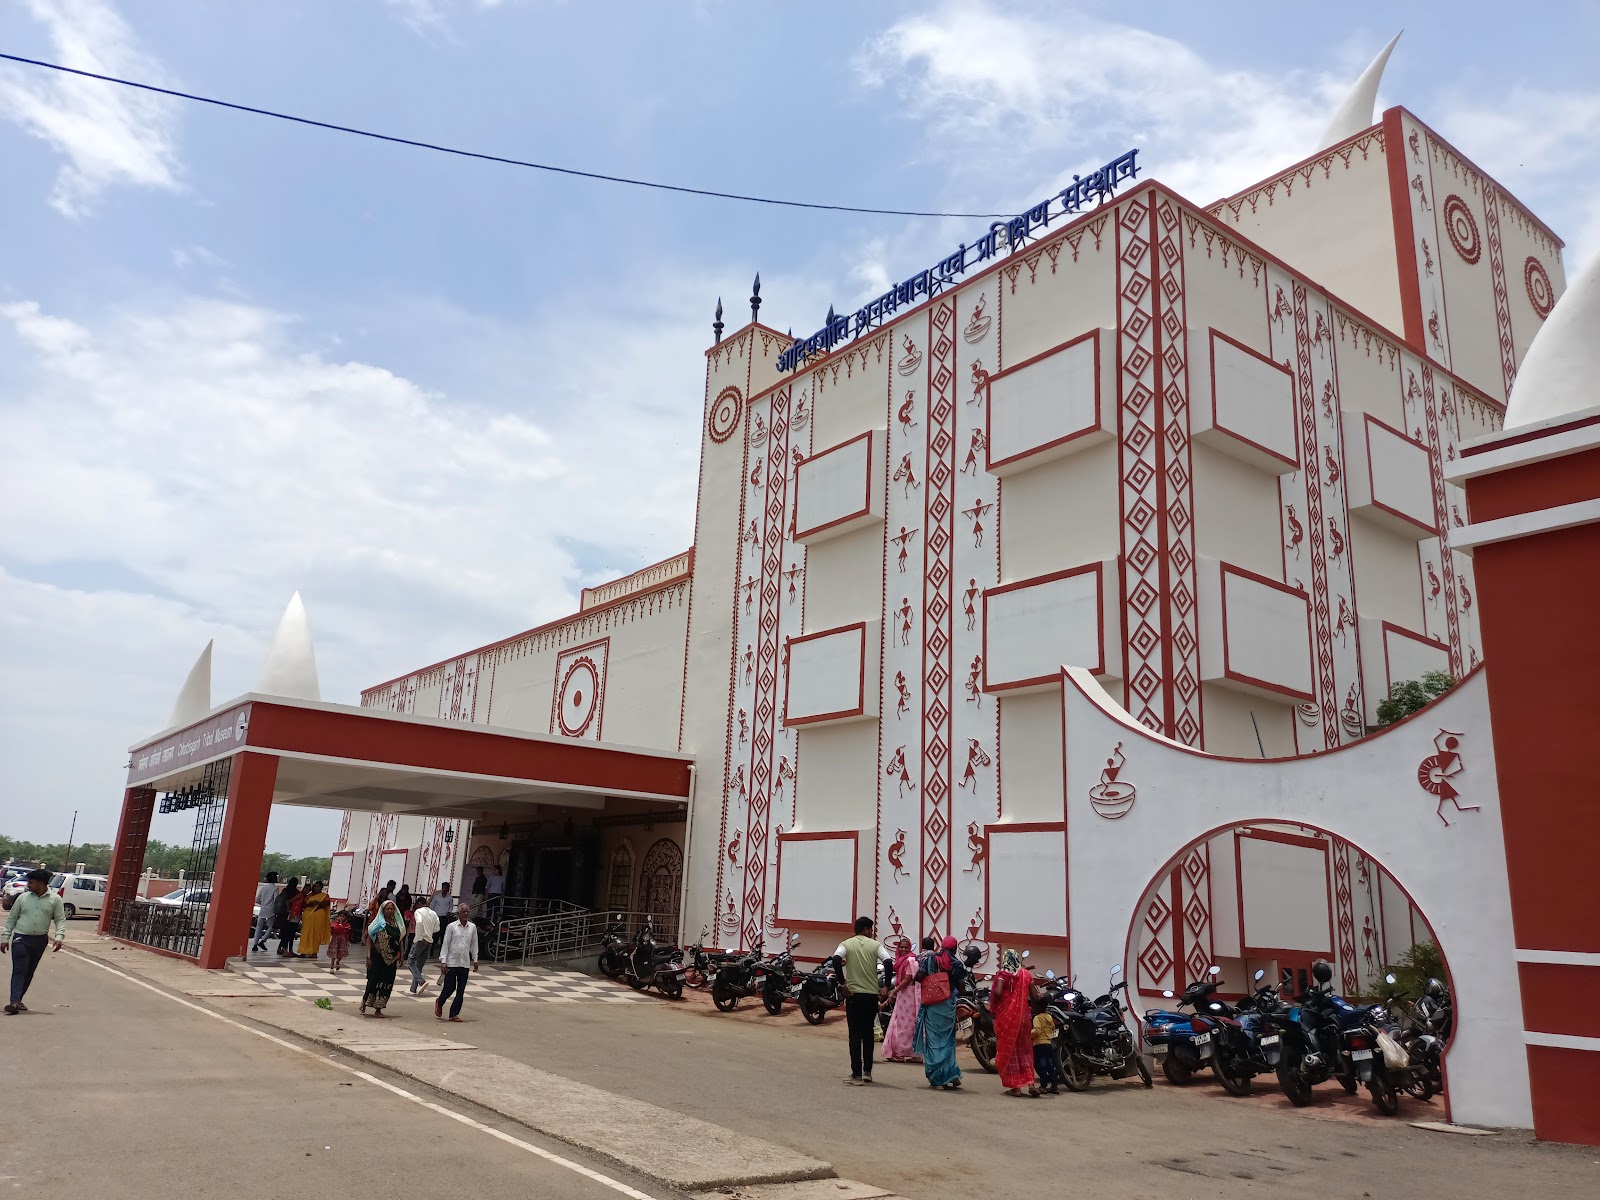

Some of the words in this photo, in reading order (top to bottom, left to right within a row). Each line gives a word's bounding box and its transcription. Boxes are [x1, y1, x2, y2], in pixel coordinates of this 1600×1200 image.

[776, 314, 851, 372] आदिमजाति
[938, 243, 966, 282] एवं
[1059, 148, 1138, 214] संस्थान
[215, 726, 233, 743] Museum
